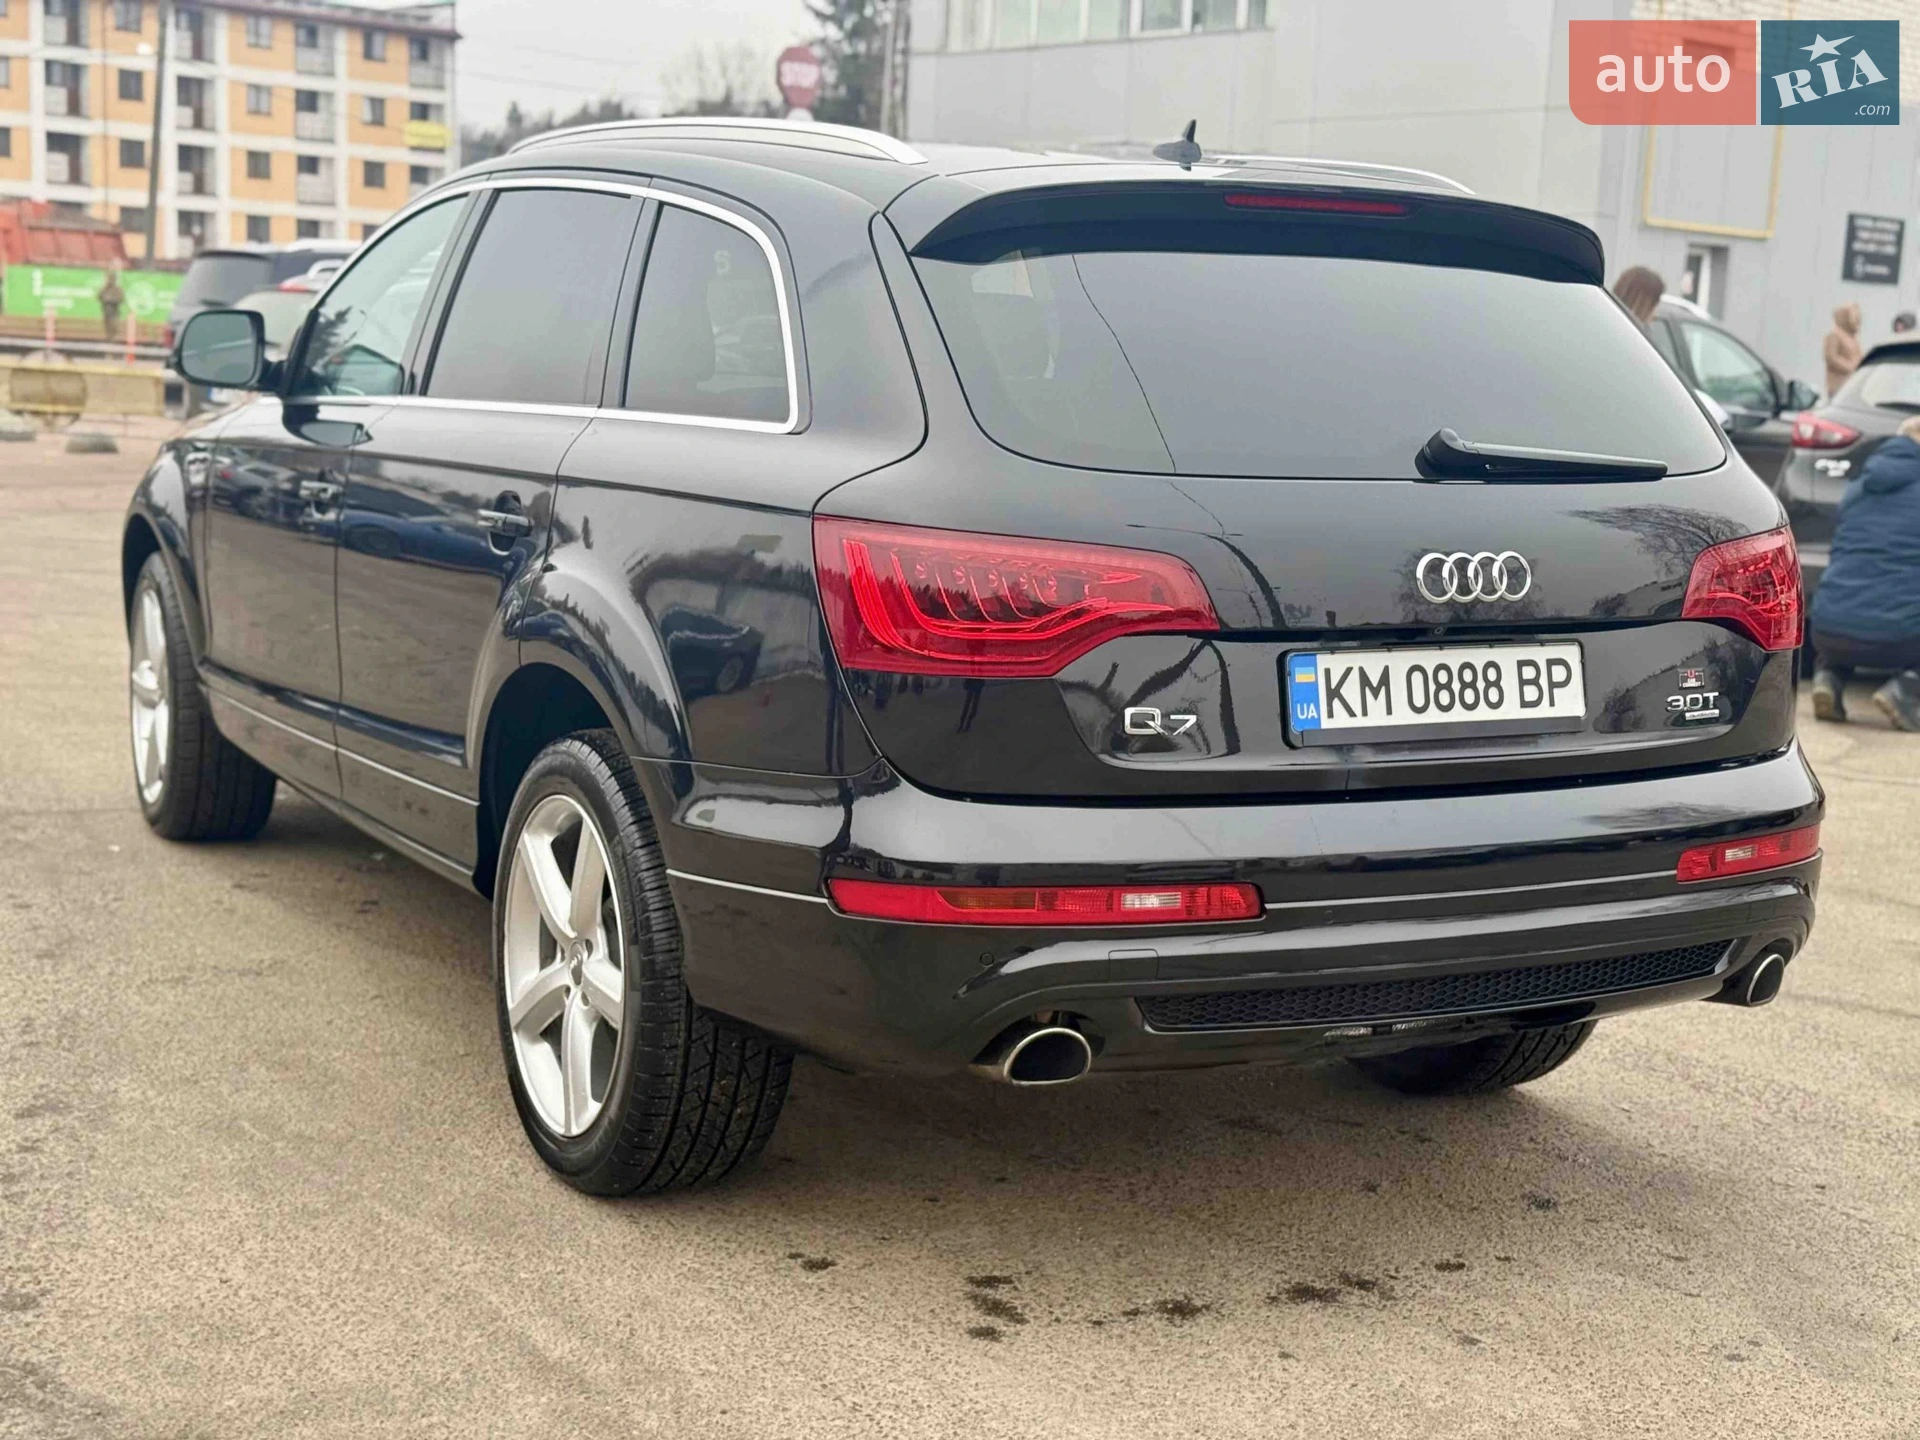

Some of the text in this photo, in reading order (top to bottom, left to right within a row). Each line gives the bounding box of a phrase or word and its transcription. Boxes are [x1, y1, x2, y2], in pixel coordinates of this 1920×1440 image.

[1323, 657, 1573, 719] KM 0888 BP
[1124, 706, 1197, 736] Q7
[1297, 702, 1318, 719] UA
